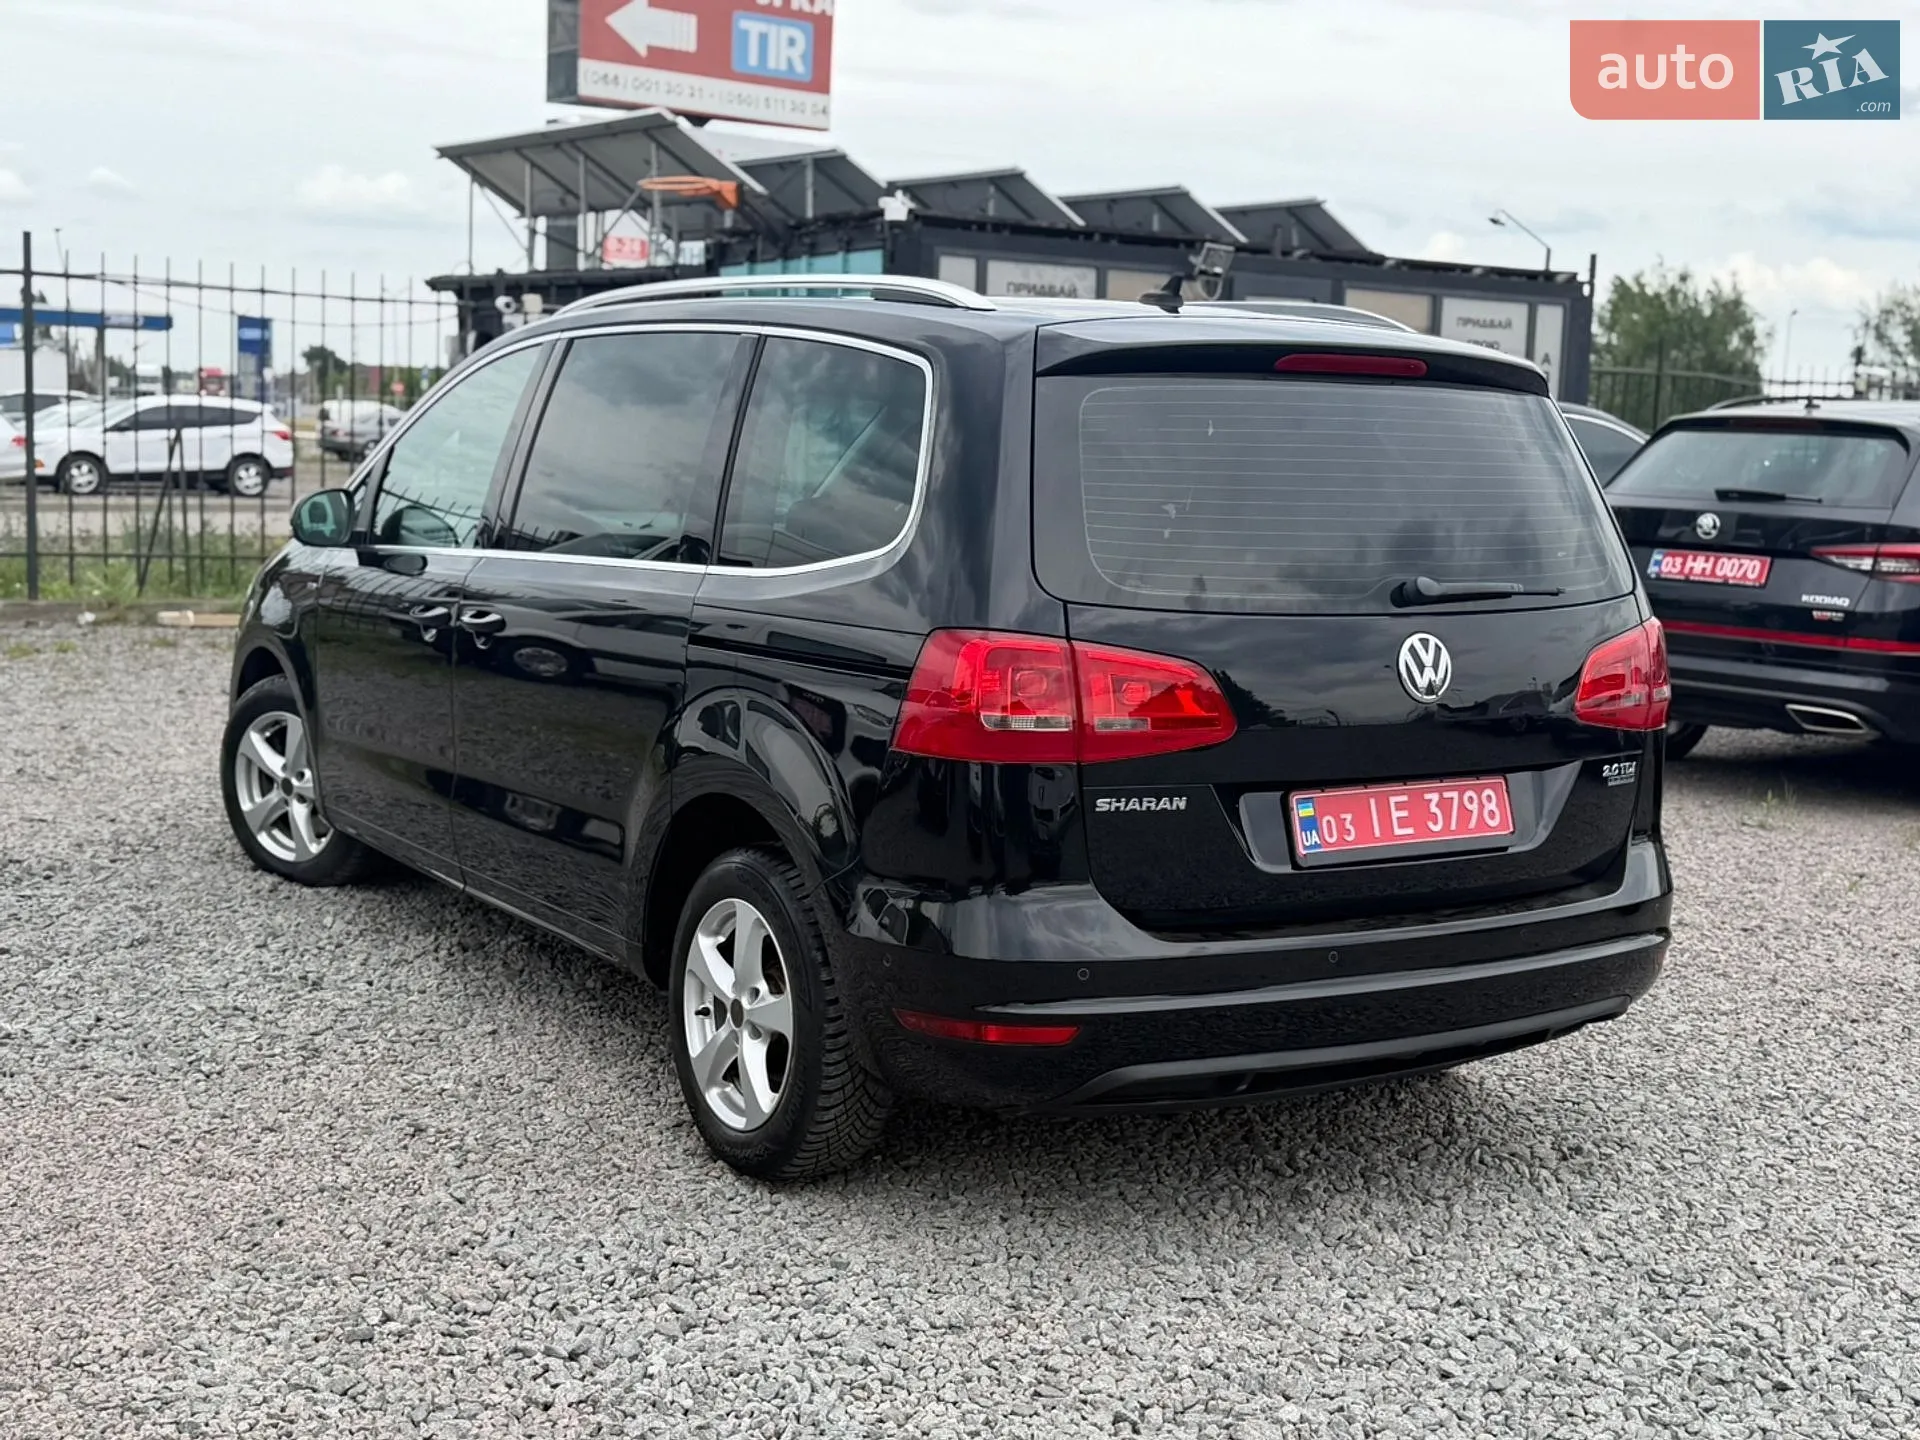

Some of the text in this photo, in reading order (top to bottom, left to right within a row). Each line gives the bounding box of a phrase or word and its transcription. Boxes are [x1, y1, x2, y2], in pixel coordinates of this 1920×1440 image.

[738, 19, 806, 75] TIR
[1661, 554, 1761, 579] 03 HH 0070
[1095, 796, 1188, 812] SHARAN
[1322, 788, 1501, 844] 03 IE 3798
[1302, 831, 1321, 847] UA
